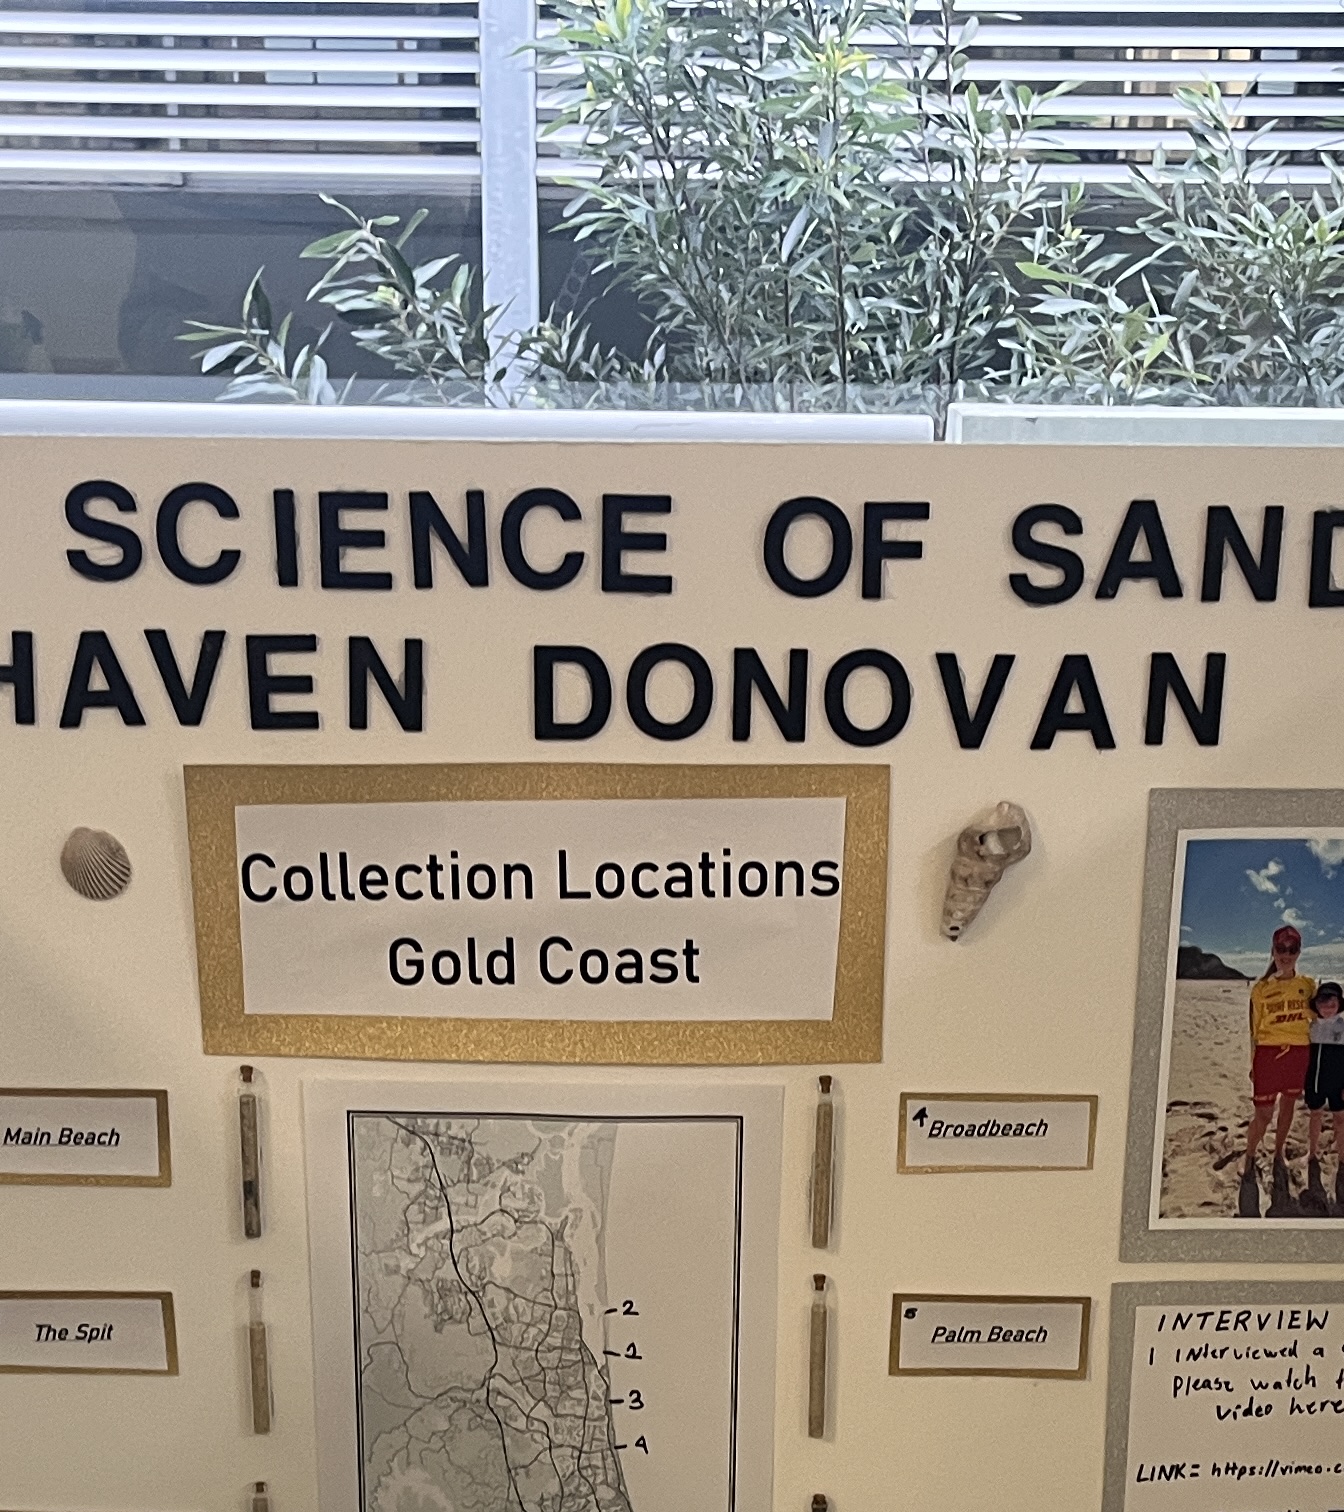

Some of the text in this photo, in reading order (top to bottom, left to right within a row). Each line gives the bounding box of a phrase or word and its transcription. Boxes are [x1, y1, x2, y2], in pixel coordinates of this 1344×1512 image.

[65, 480, 672, 595] SCIENCE
[764, 497, 930, 600] OF
[534, 643, 1226, 750] DONOVAN
[240, 849, 840, 903] Collection Locations
[390, 937, 699, 985] Gold Coast
[3, 1128, 120, 1146] Main Beach
[928, 1118, 1049, 1138] Broadbeach
[622, 1300, 639, 1315] 2
[1158, 1310, 1329, 1331] INTERVIEW
[35, 1323, 113, 1343] The Spit
[931, 1326, 1049, 1344] Palm Beach
[625, 1342, 642, 1360] 1
[1313, 1346, 1324, 1358] a
[1250, 1365, 1316, 1391] watch
[629, 1390, 644, 1410] 3
[1216, 1397, 1273, 1420] video
[635, 1435, 648, 1454] 4
